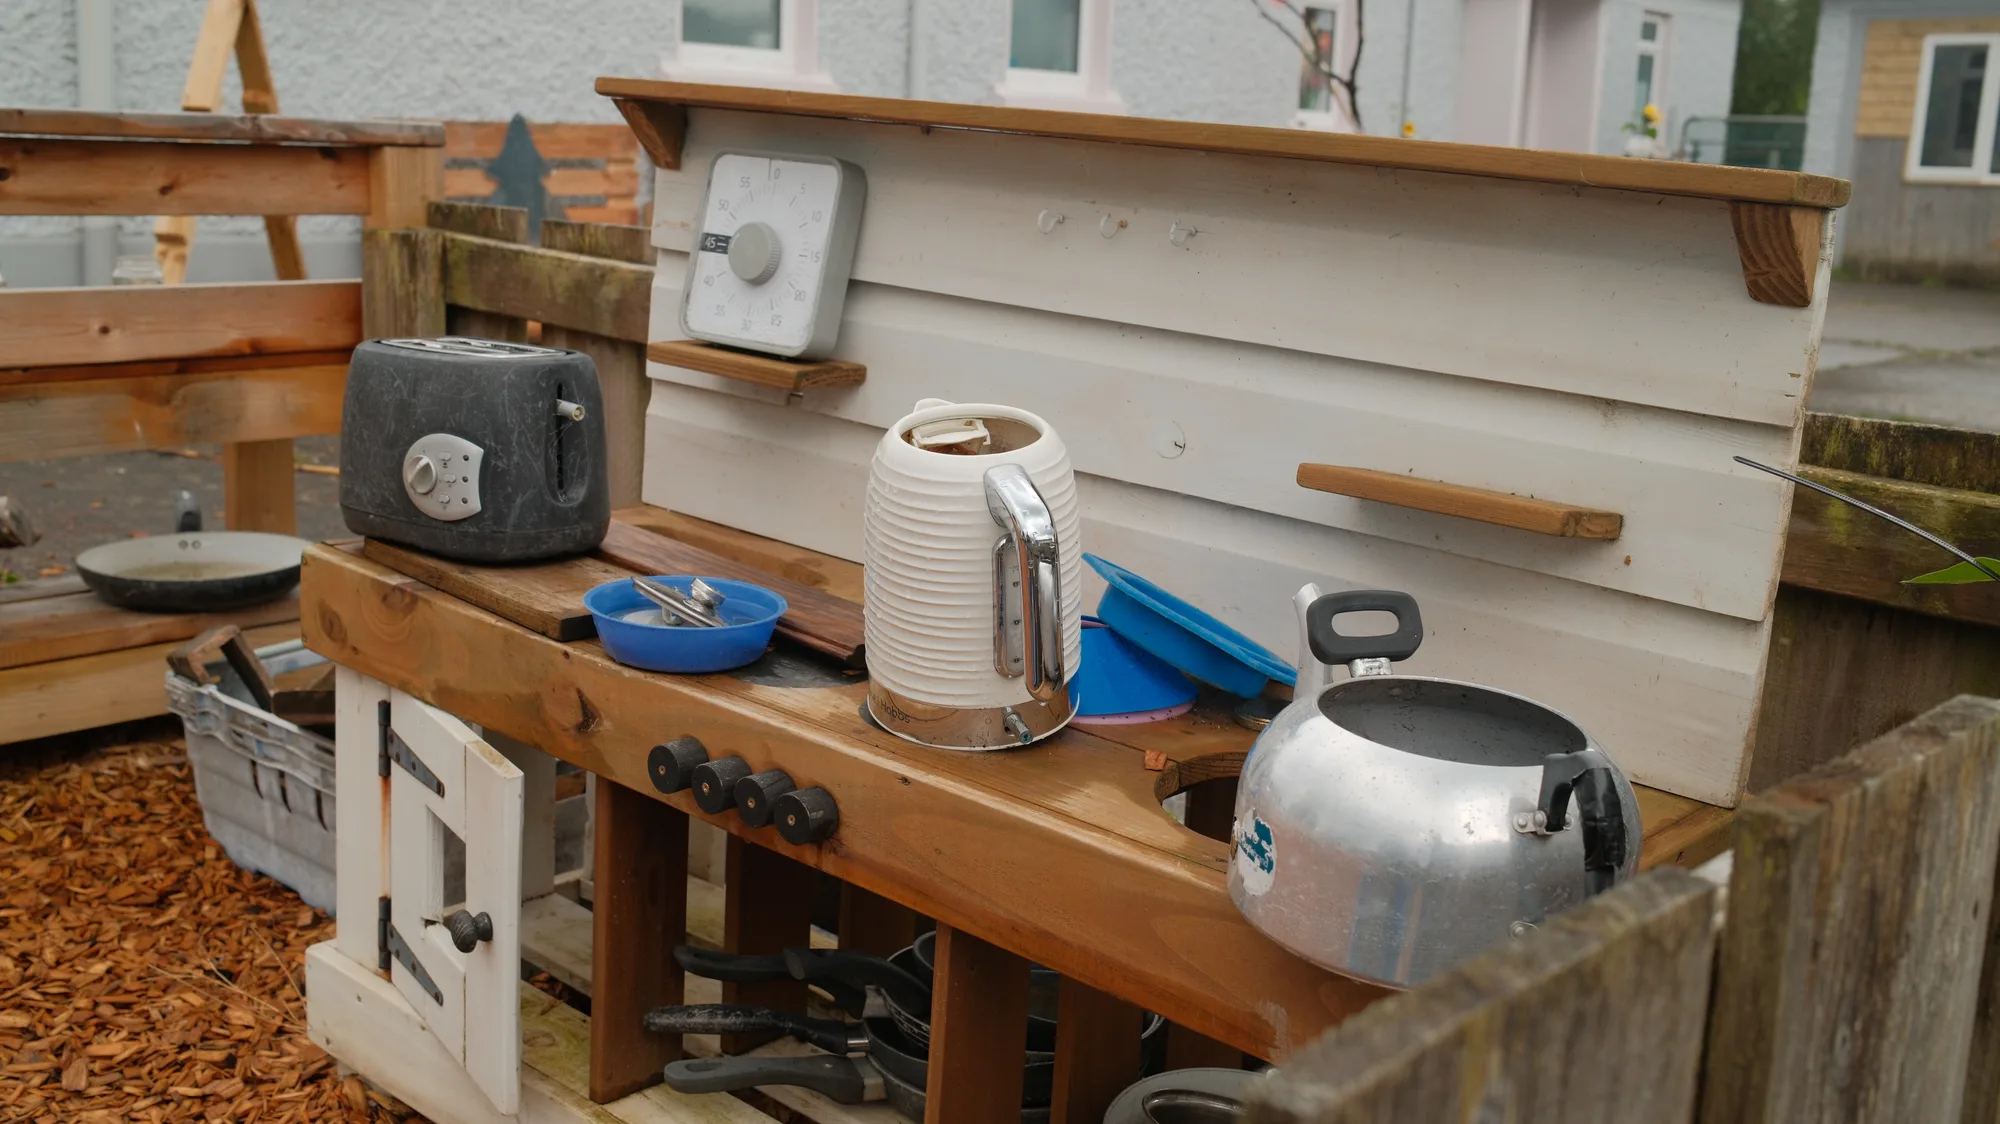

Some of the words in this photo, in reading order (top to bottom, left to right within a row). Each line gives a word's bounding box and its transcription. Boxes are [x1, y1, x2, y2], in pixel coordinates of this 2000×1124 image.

[739, 176, 752, 188] 55
[799, 183, 806, 194] 5
[717, 199, 729, 211] 50
[811, 210, 821, 222] 10
[705, 237, 716, 248] 45
[811, 251, 820, 263] 15
[880, 697, 911, 724] Hobbs
